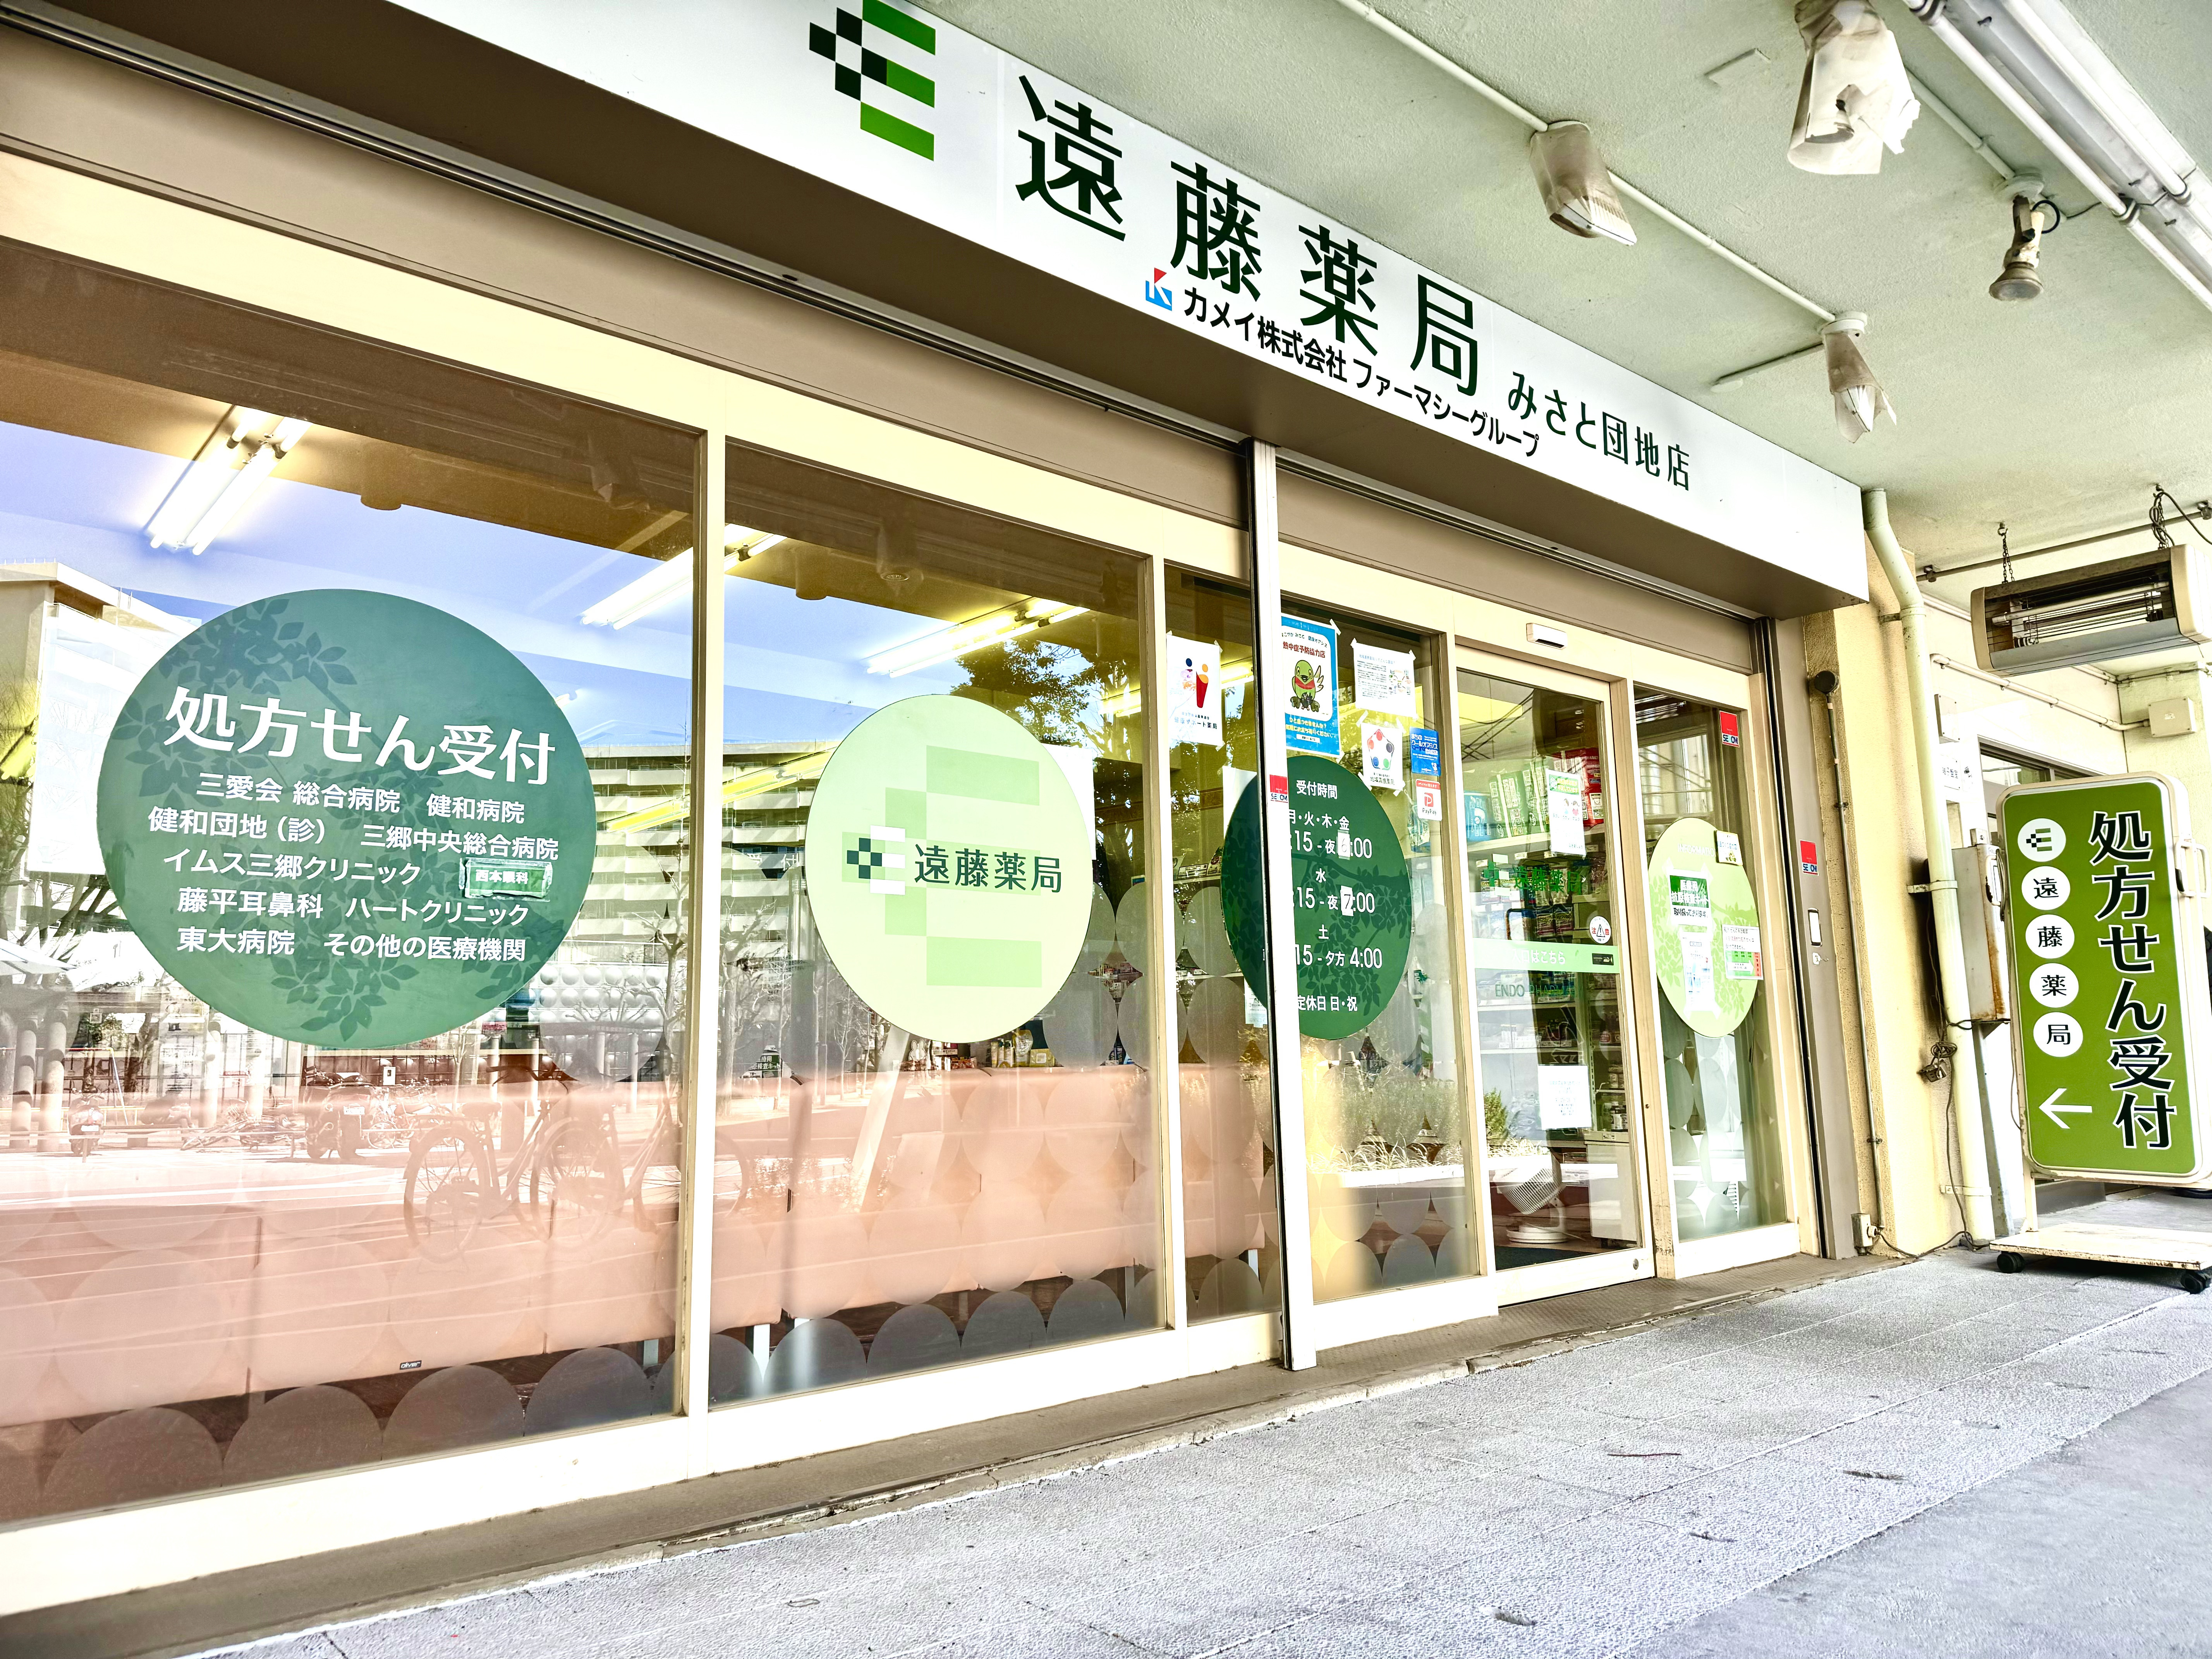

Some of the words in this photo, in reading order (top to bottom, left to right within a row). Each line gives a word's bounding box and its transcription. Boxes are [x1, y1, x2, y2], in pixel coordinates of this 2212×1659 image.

[1015, 76, 1477, 396] 遠藤薬局
[1184, 287, 1347, 382] カメイ株式会社
[1353, 359, 1539, 457] ファーマシーグループ
[1508, 372, 1689, 491] みさと団地店
[164, 686, 555, 785] 処方せん受付
[1723, 734, 1738, 744] SEOM
[197, 773, 283, 803] 三愛会
[293, 781, 400, 812] 総合病院
[427, 793, 524, 823] 健和病院
[1297, 780, 1338, 799] 受付時間
[361, 824, 558, 860] 三郷中央総合病院
[164, 848, 420, 885] イムス三郷クリニック
[476, 869, 528, 884] 西本眼科
[915, 844, 1061, 892] 遠藤薬局
[1316, 868, 1326, 883] 水
[1803, 864, 1817, 872] SEOM
[177, 887, 323, 918] 藤平耳鼻科
[345, 898, 528, 926] ハートクリニック
[177, 926, 295, 955] 東大病院
[324, 934, 525, 961] その他の医療機関
[1318, 924, 1329, 939] 土
[1512, 949, 1565, 964] 入口はこちら
[2033, 878, 2070, 1044] 遠藤薬局
[1495, 984, 1525, 997] ENDO
[2089, 811, 2177, 1149] 処方せん受付
